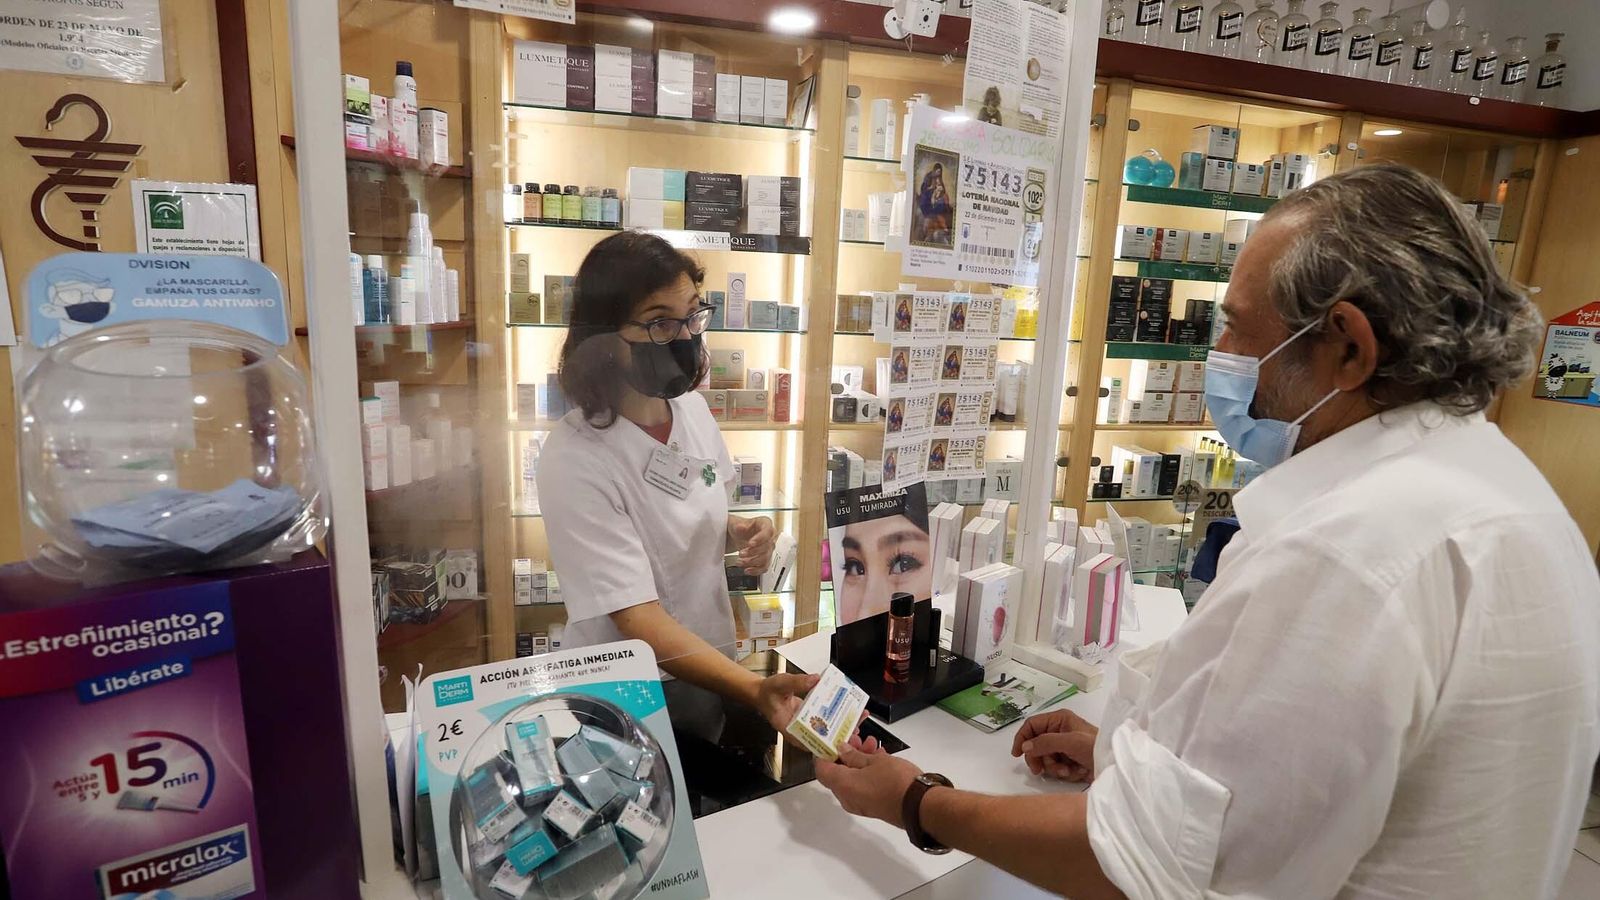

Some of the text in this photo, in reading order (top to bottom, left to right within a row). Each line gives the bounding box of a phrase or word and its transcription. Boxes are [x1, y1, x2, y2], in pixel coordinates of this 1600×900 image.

[39, 19, 55, 29] DE
[57, 21, 69, 30] 23
[58, 33, 84, 43] 1.94
[519, 52, 590, 68] LUXMETIQUE
[964, 163, 1022, 194] 75143
[962, 191, 989, 203] LOTERÍA
[964, 210, 971, 218] 22
[972, 202, 1009, 216] DE NAVIDAD
[132, 298, 276, 308] GAMUZA ANTIVAHO
[1555, 329, 1590, 337] BALNEUM
[995, 475, 1011, 492] M
[1178, 484, 1200, 495] 20%
[859, 488, 908, 503] MAXIMIZA
[1204, 491, 1236, 510] 20
[836, 506, 851, 516] USU
[860, 499, 898, 513] TU MIRADA
[1203, 510, 1236, 518] DESCUENT
[0, 613, 197, 660] Estreñimiento
[479, 668, 519, 684] ACCIÓN
[583, 650, 635, 666] INMEDIATA
[90, 661, 184, 696] Libérate
[438, 682, 468, 692] MARTI
[438, 688, 469, 699] DERM
[437, 719, 464, 743] 2€
[438, 750, 458, 761] PVP
[90, 742, 167, 795] 15
[53, 773, 98, 789] Actúa
[163, 771, 200, 789] min
[58, 782, 99, 798] entre
[121, 841, 239, 888] micralax
